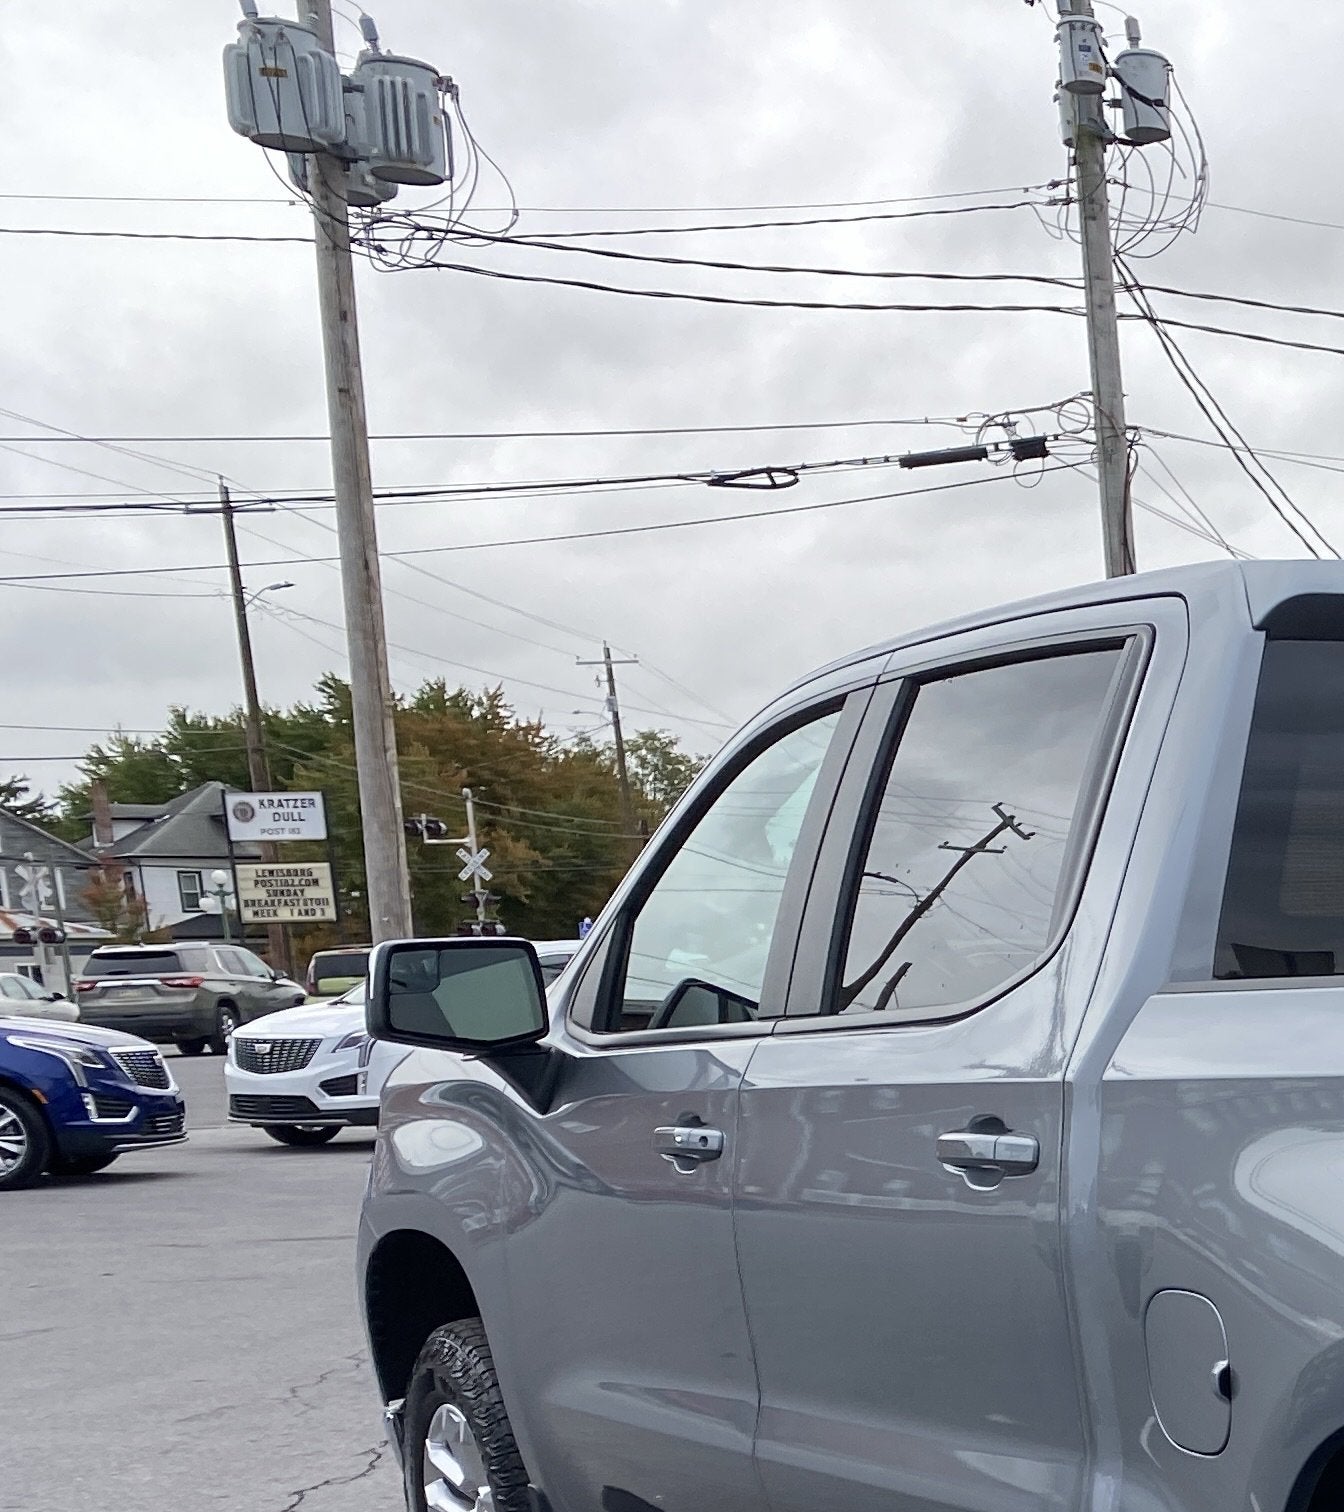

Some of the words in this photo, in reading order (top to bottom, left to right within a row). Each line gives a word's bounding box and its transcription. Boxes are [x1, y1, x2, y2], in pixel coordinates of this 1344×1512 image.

[258, 798, 317, 809] KRATZER
[273, 811, 306, 822] DULL
[260, 827, 285, 836] POST
[266, 889, 305, 897] SUNDAY
[252, 908, 279, 918] WEEK
